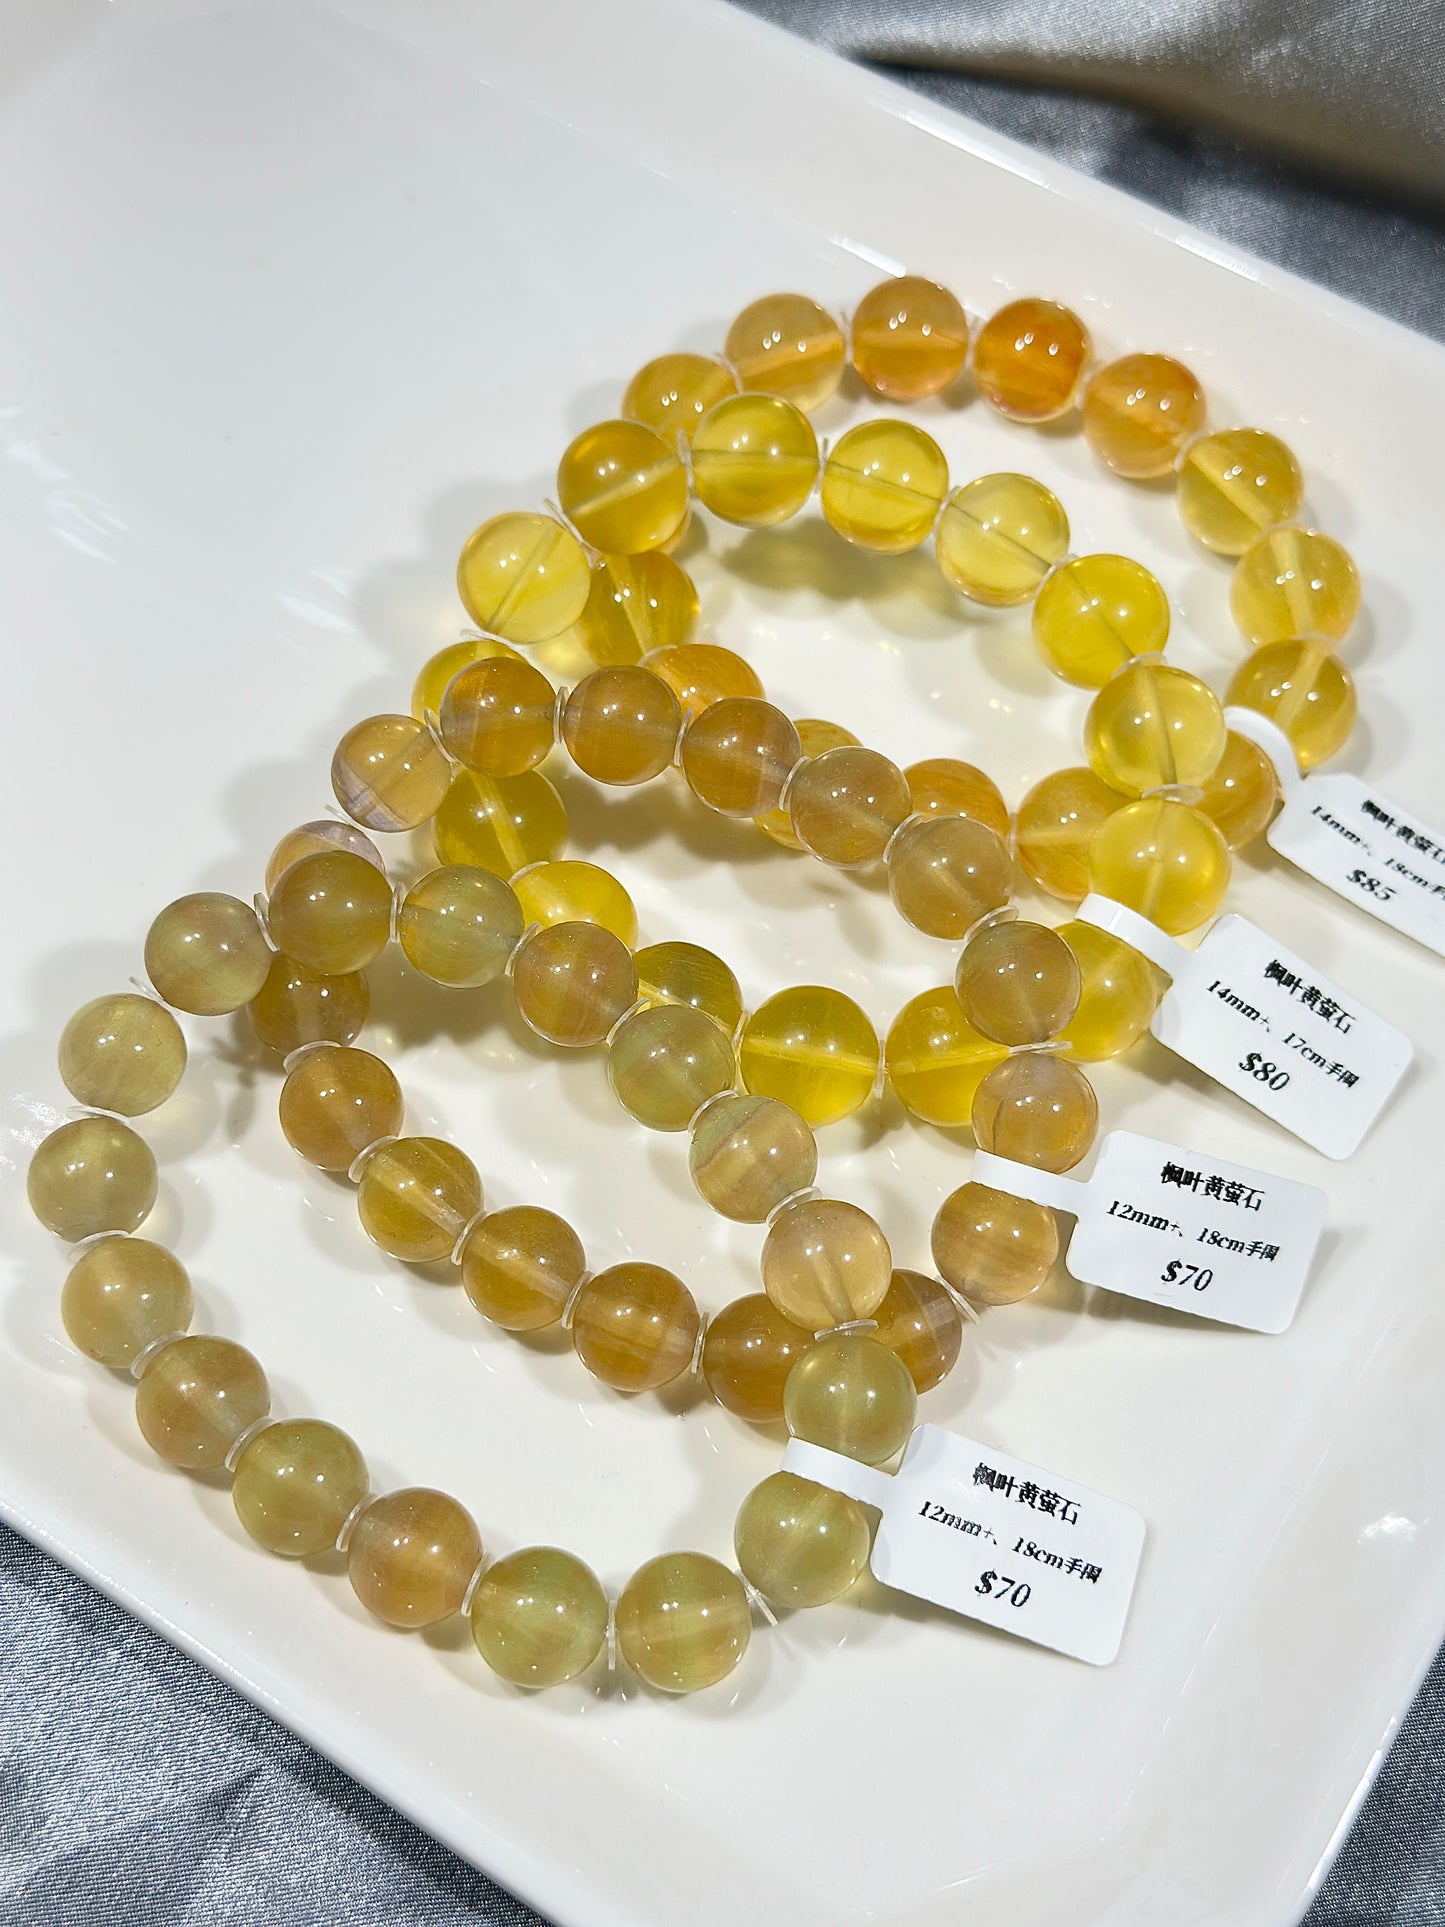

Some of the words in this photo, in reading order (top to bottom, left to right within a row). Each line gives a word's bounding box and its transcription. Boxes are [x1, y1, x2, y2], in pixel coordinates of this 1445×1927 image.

[1347, 870, 1396, 900] $85
[1239, 1053, 1290, 1090] $80
[1161, 1259, 1213, 1291] $70
[975, 1570, 1031, 1607] $70
